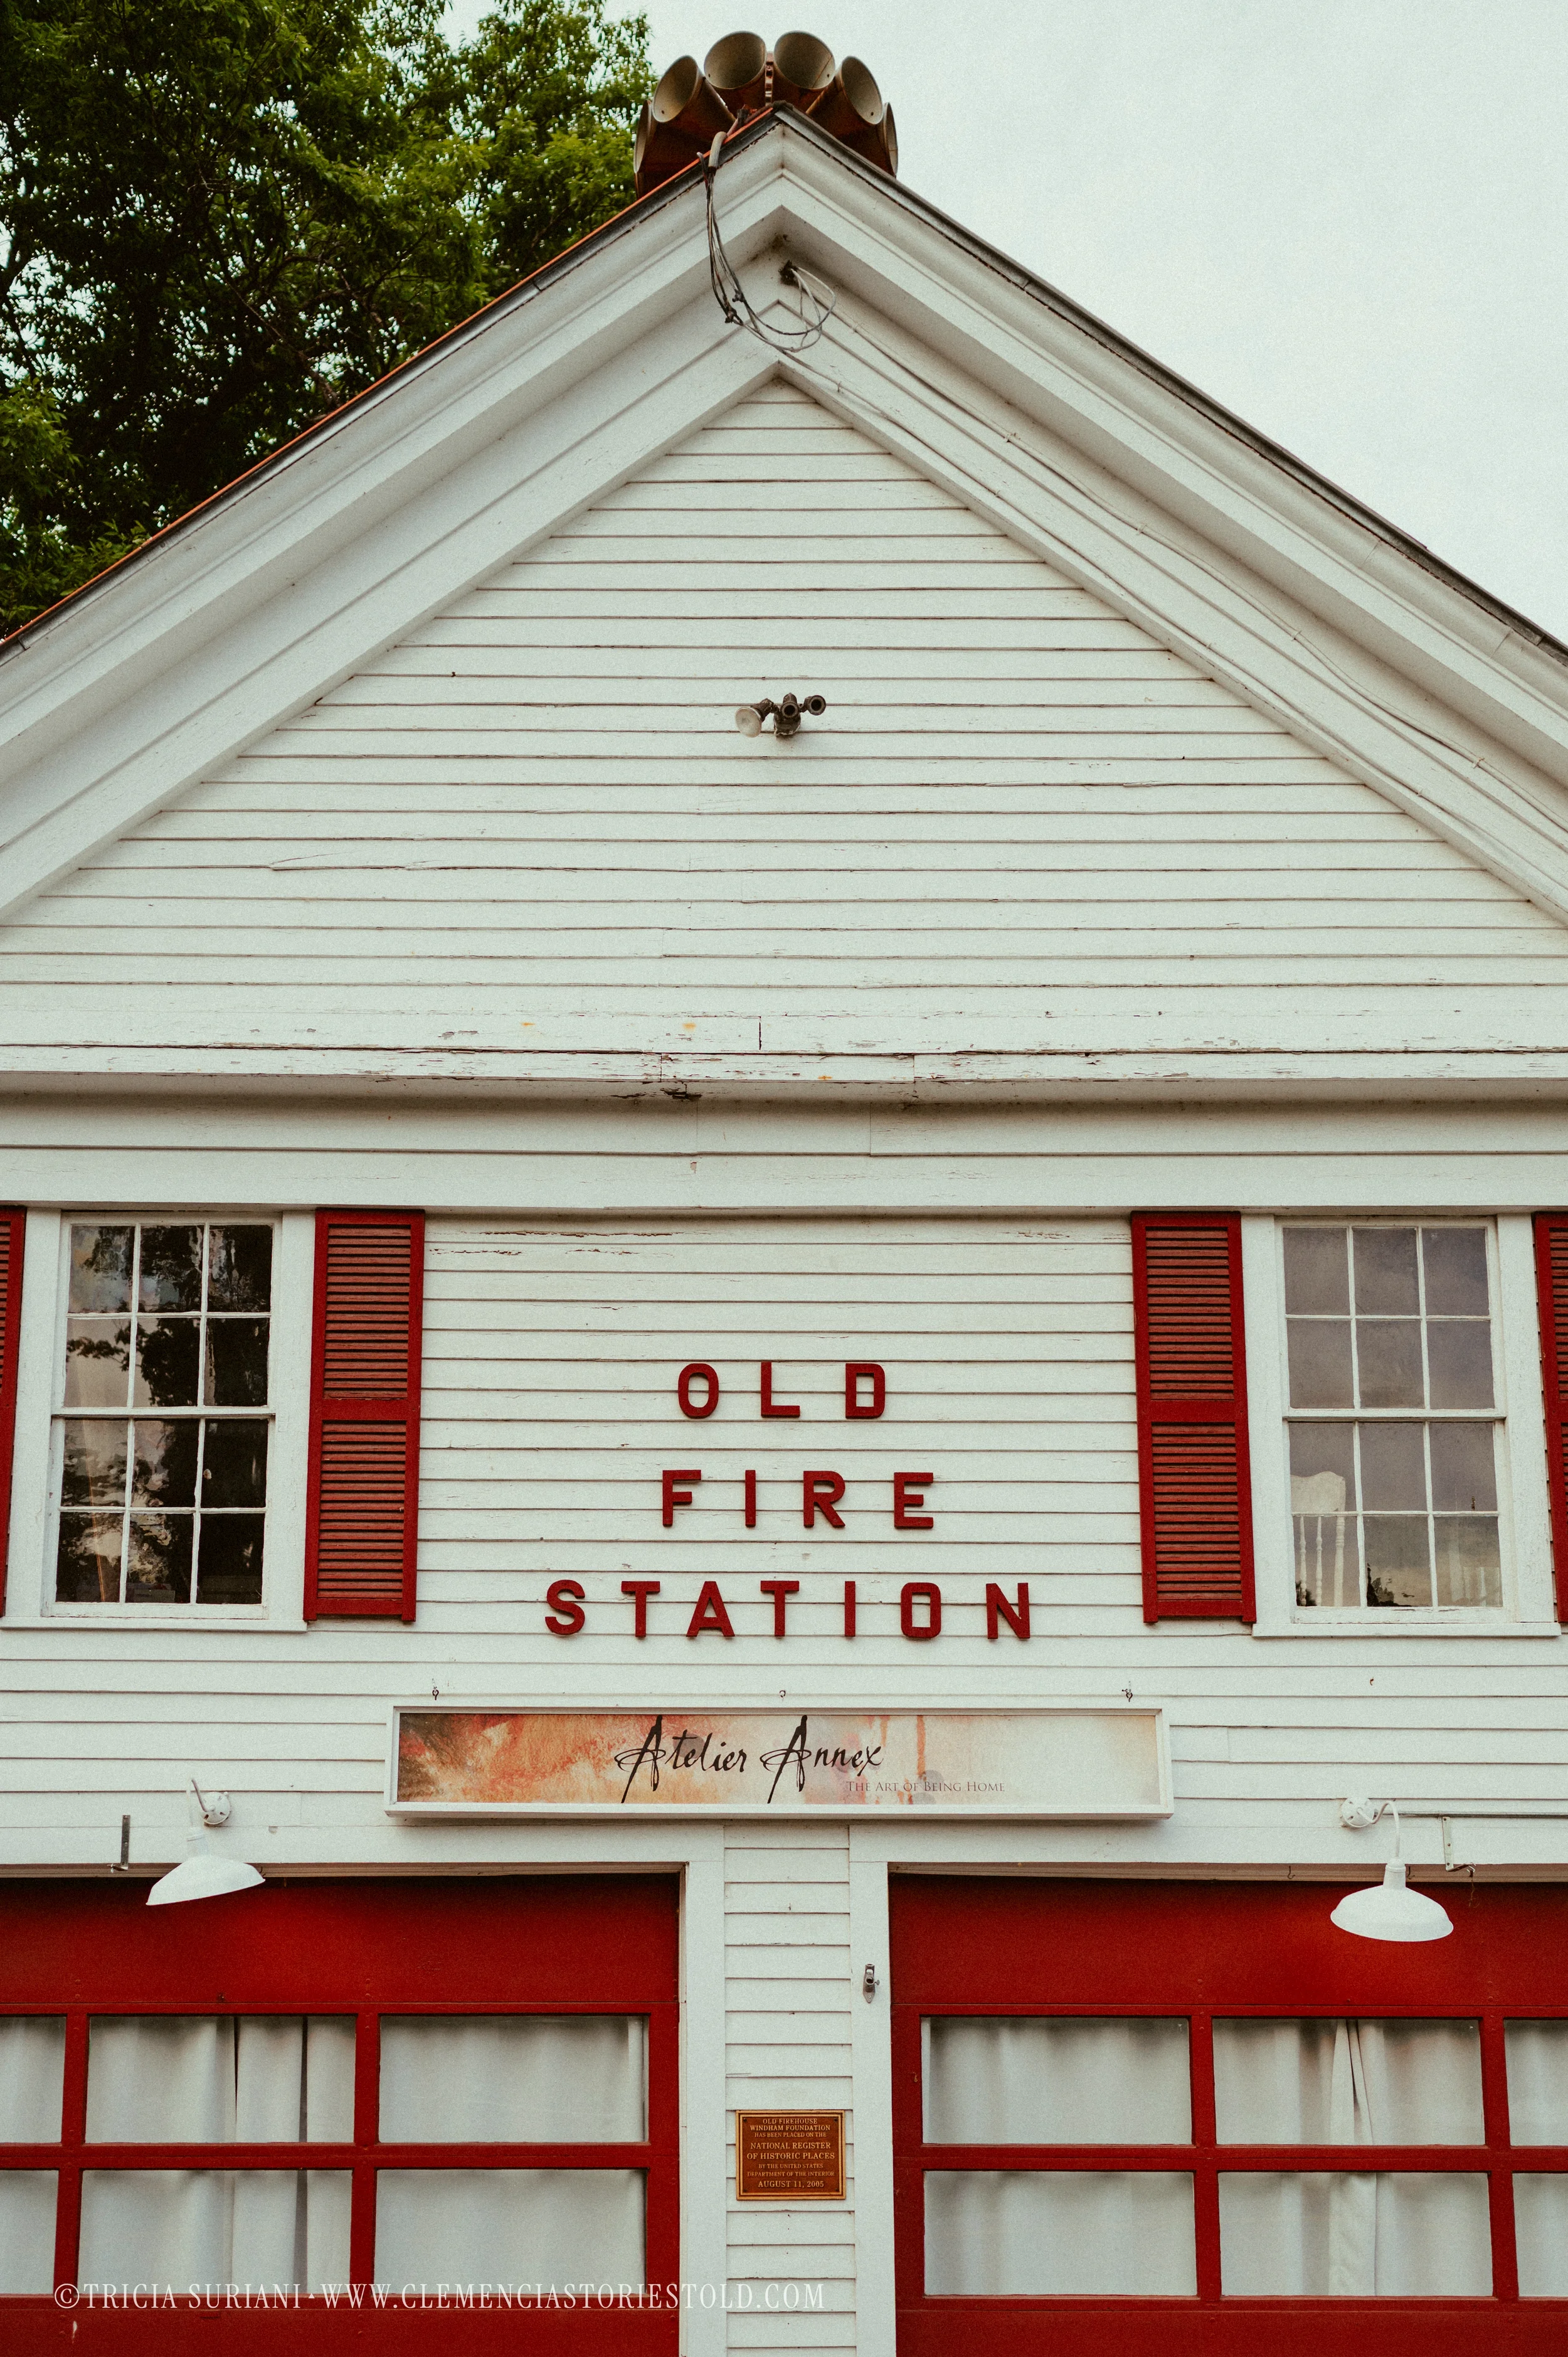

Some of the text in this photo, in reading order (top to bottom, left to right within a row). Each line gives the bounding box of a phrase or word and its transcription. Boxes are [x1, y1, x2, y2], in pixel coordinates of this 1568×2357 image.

[677, 1361, 886, 1418] OLD
[662, 1469, 934, 1529] FIRE
[544, 1579, 1030, 1639] STATION
[614, 1715, 884, 1804] Atelier Annex
